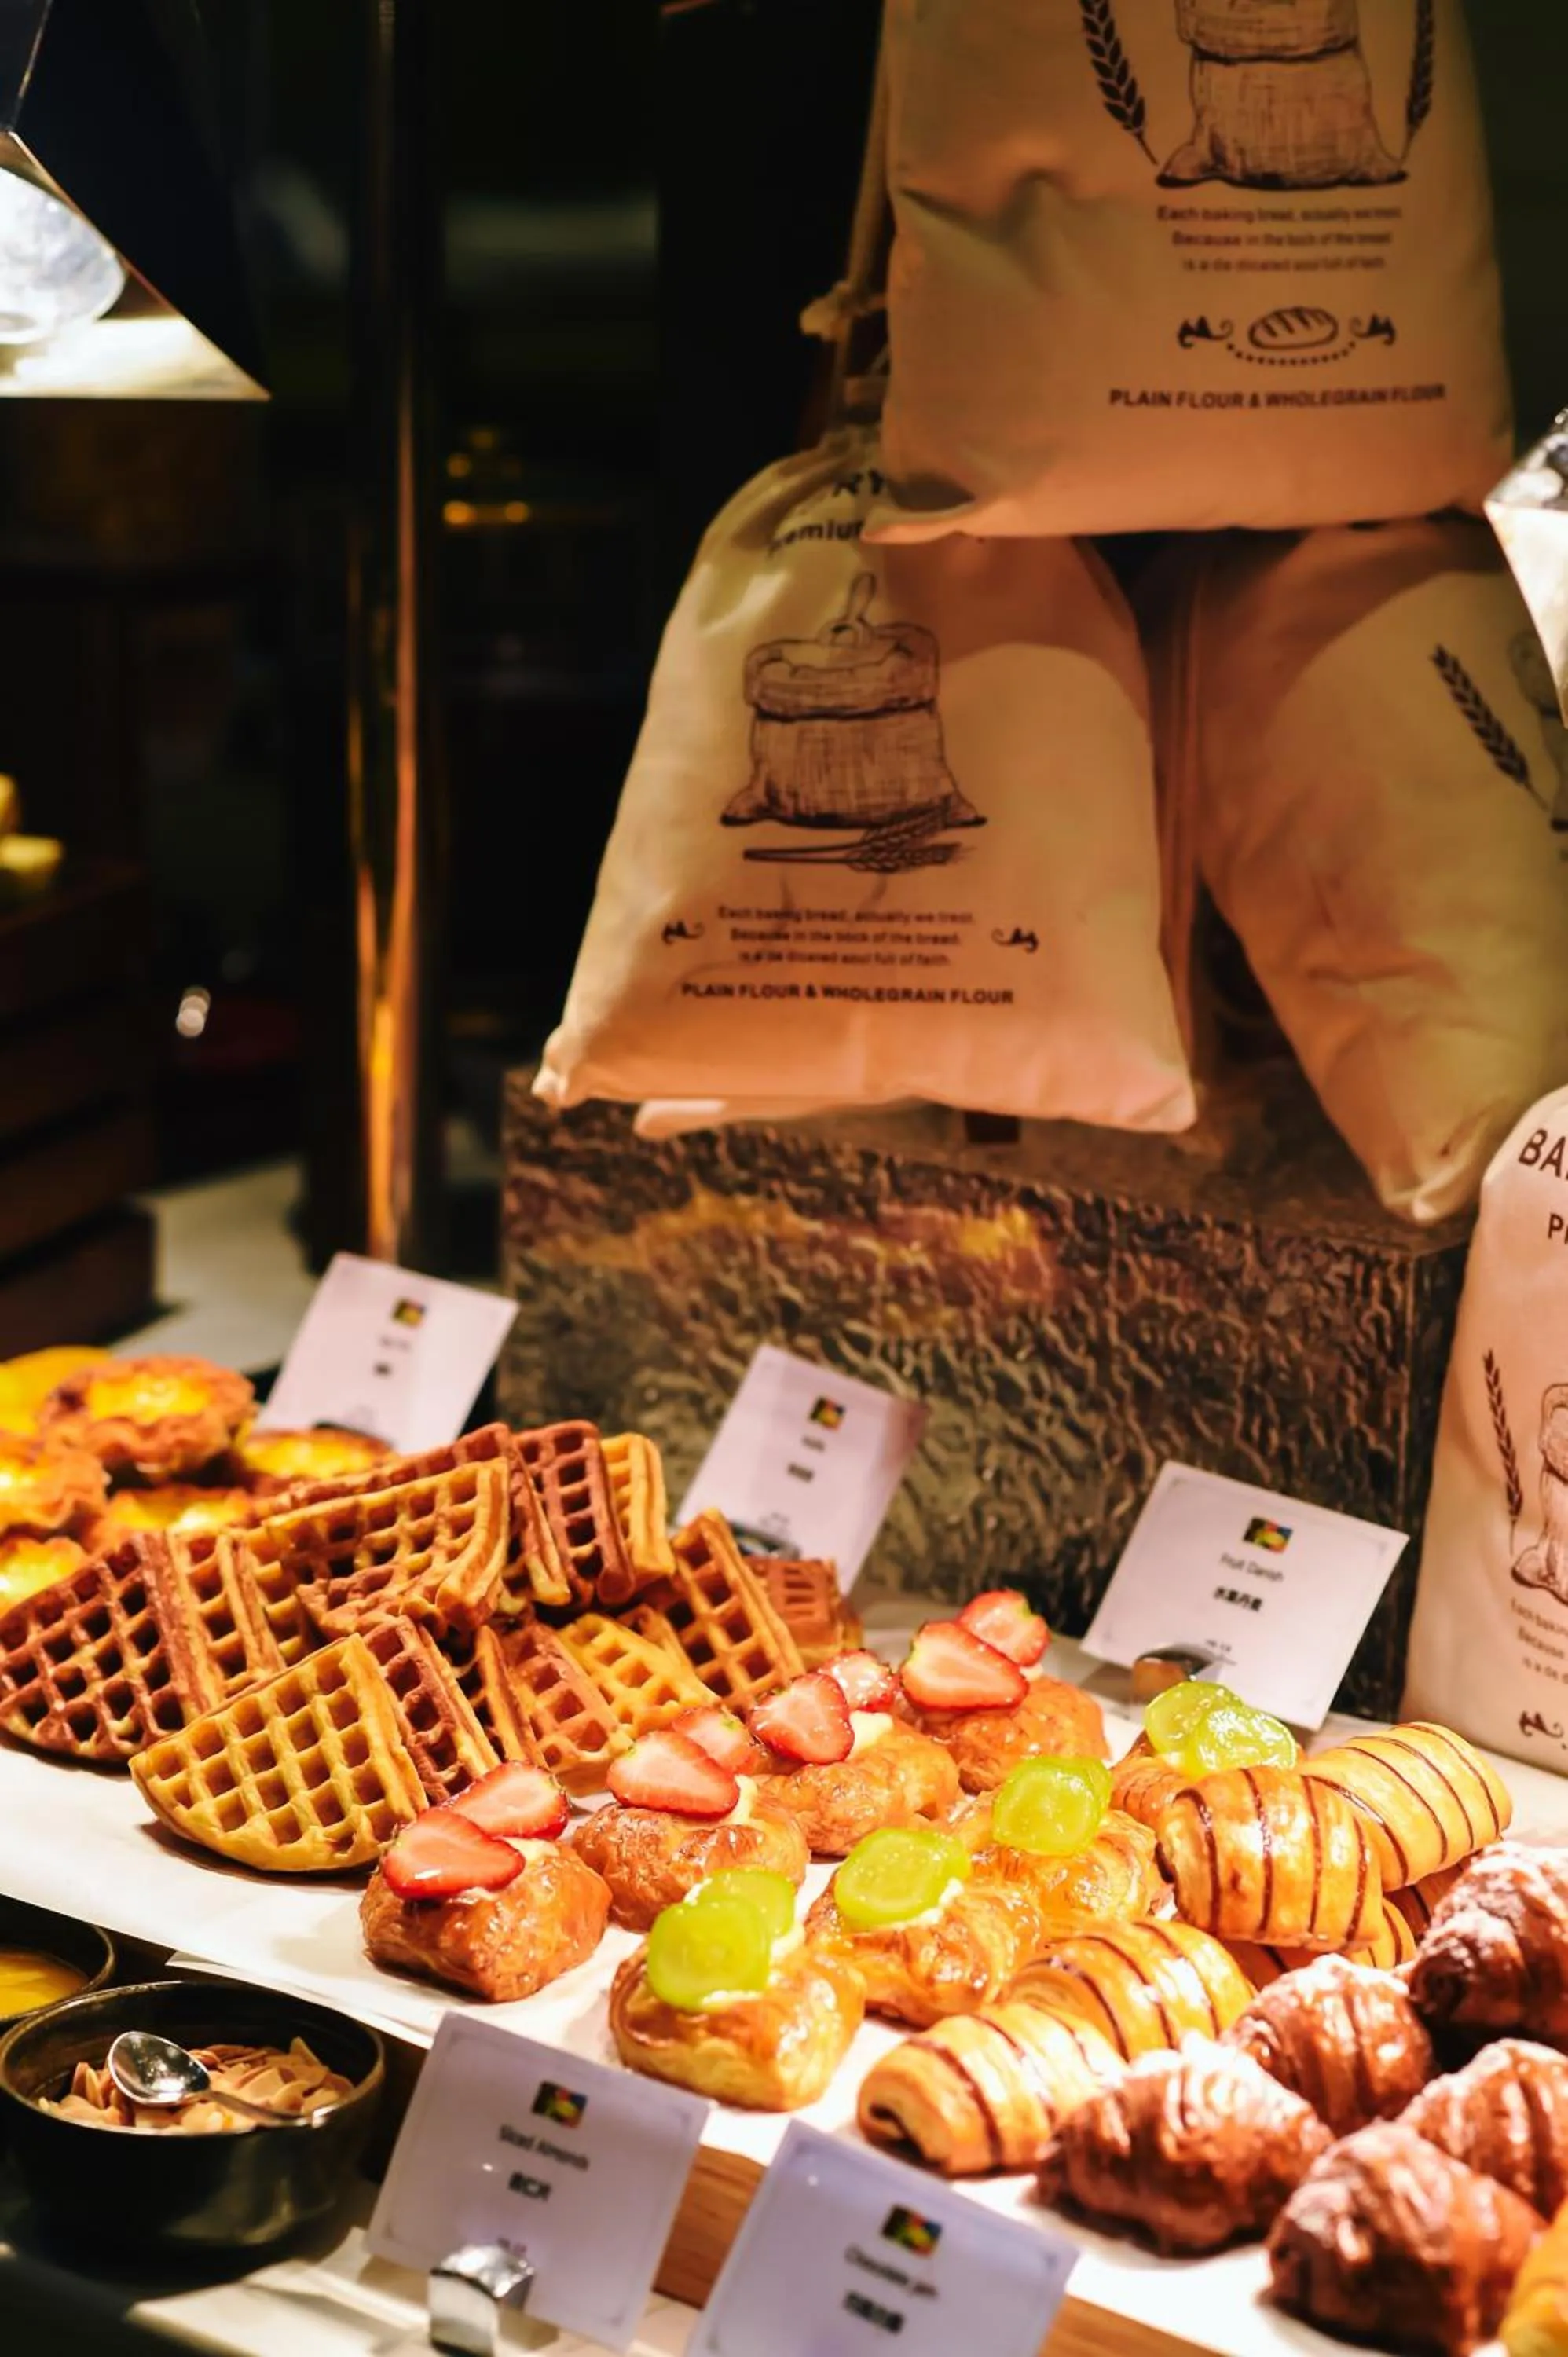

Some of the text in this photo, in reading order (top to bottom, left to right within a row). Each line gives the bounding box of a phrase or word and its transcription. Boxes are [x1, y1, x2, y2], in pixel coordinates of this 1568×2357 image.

[1110, 390, 1172, 407] PLAIN
[1175, 390, 1244, 409] FLOUR
[1264, 389, 1387, 408] WHOLEGRAIN
[1390, 384, 1446, 404] FLOUR
[682, 981, 1015, 1006] PLAIN FLOUR & WHOLEGRAIN FLOUR
[1518, 1128, 1568, 1181] BA
